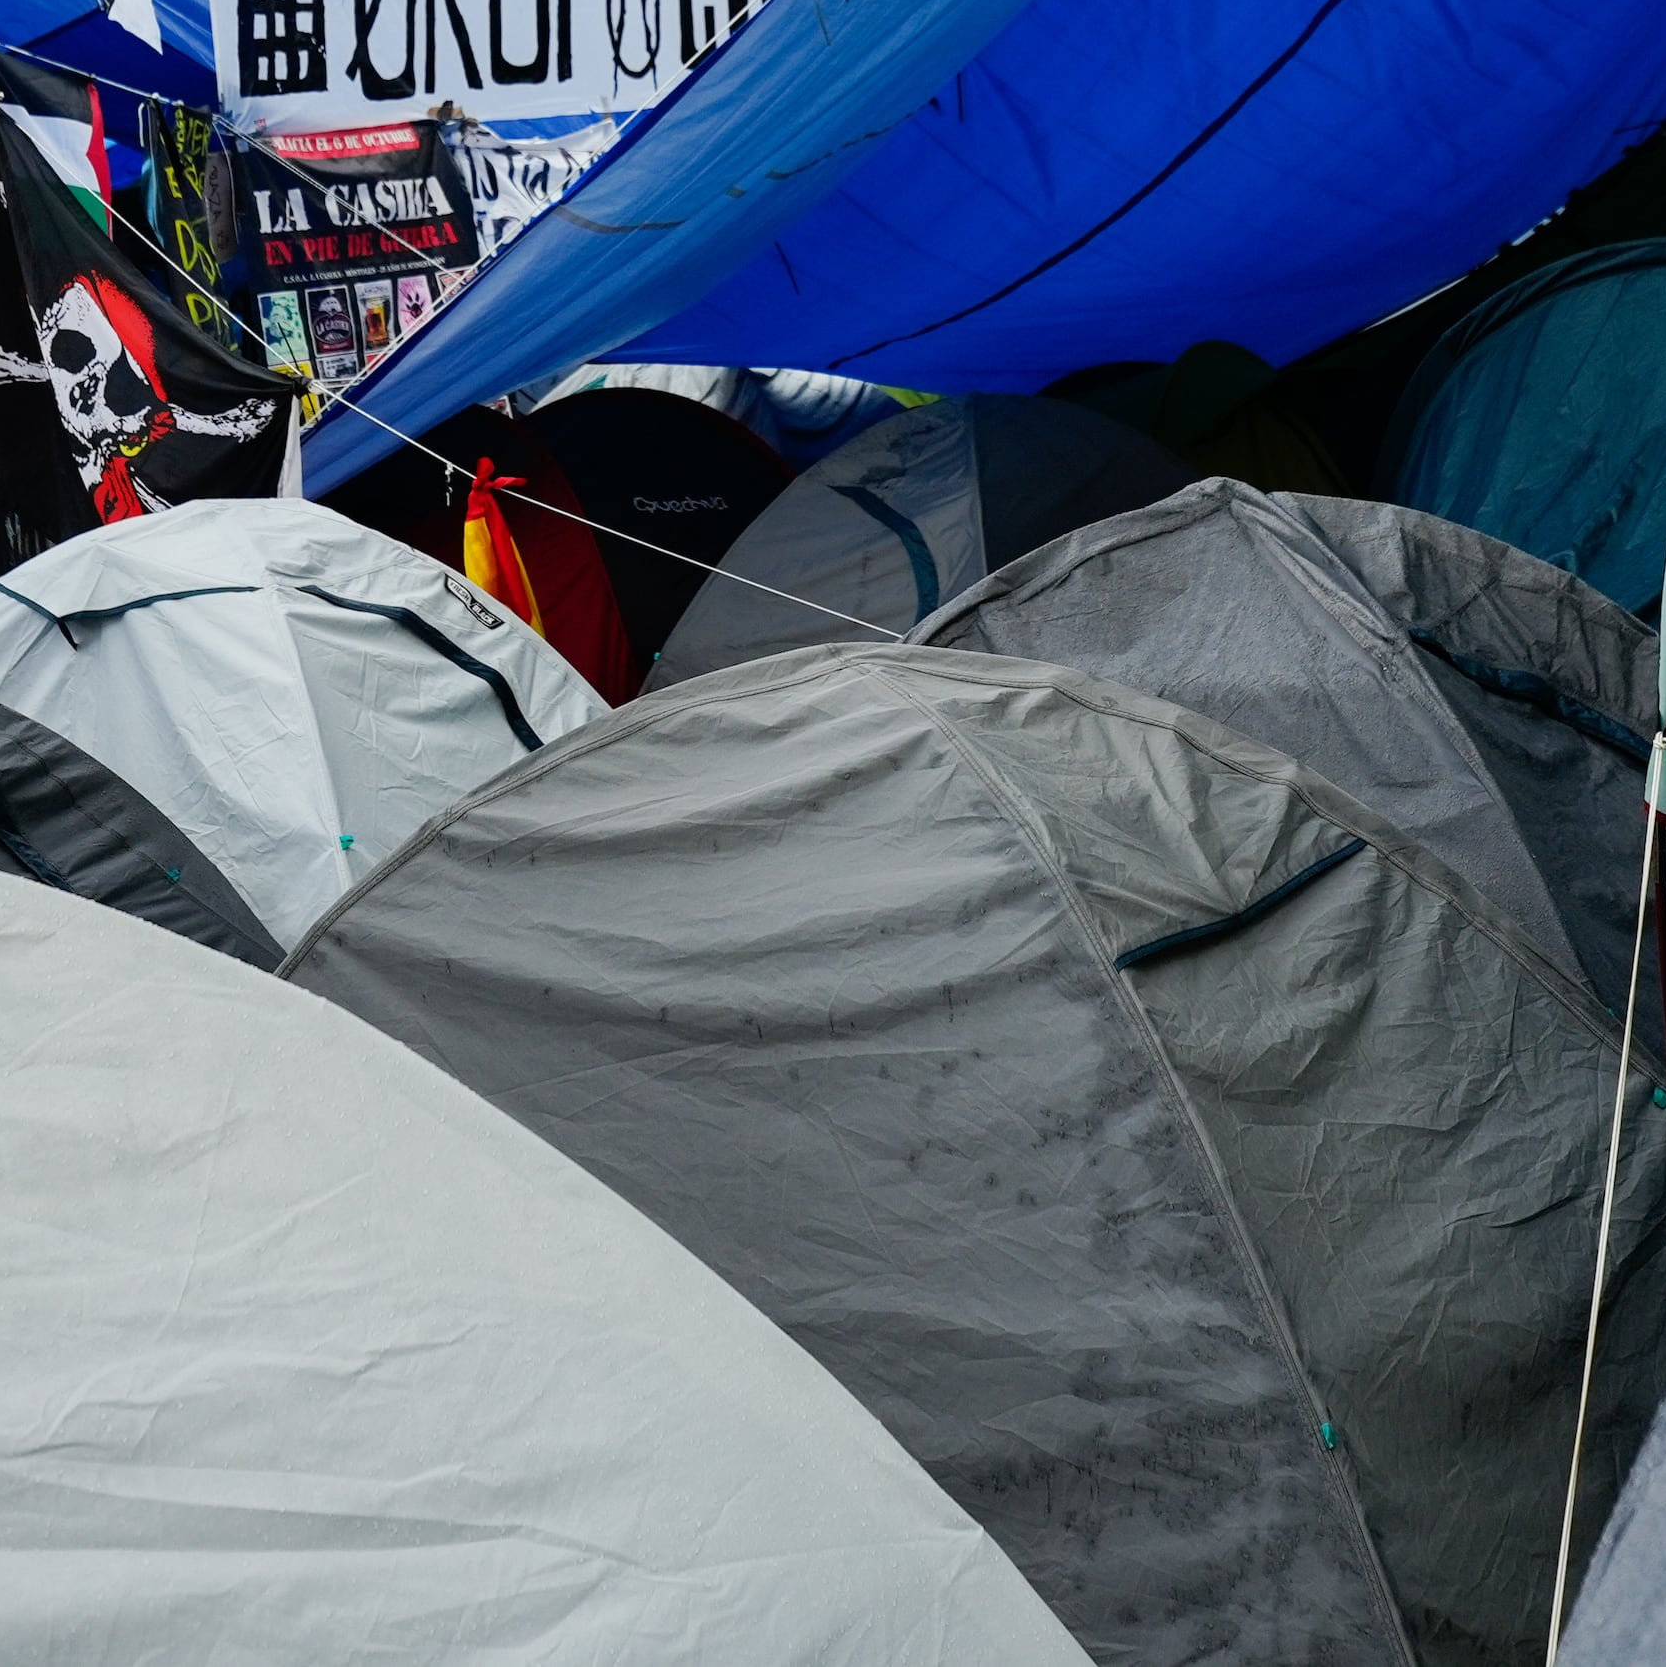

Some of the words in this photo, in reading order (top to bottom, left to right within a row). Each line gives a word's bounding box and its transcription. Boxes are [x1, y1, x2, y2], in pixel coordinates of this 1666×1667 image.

[362, 128, 416, 147] OCTUBRE
[253, 188, 312, 234] LA
[324, 176, 454, 227] CASIKA
[264, 239, 294, 267] EN
[302, 236, 340, 262] PIE
[348, 232, 374, 258] DE
